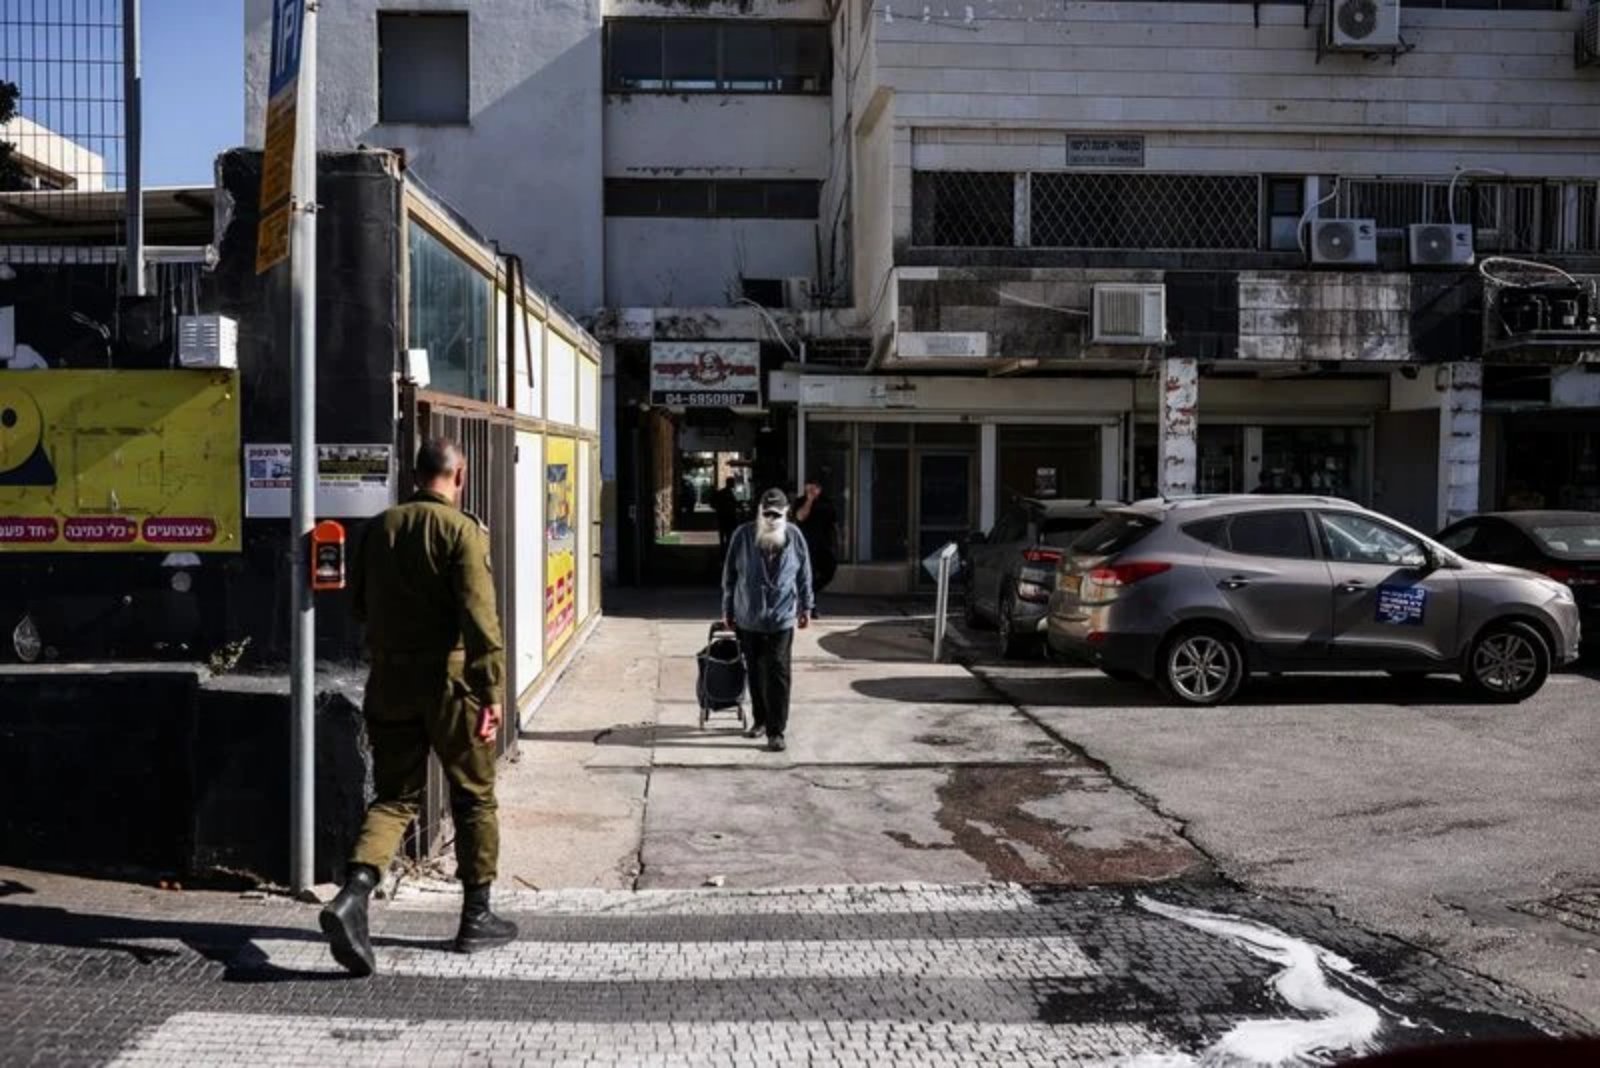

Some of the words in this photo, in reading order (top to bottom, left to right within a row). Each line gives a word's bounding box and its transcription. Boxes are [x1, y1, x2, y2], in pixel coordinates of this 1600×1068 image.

[27, 525, 47, 537] חד
[106, 523, 126, 537] כלי
[147, 525, 203, 537] צעצועים
